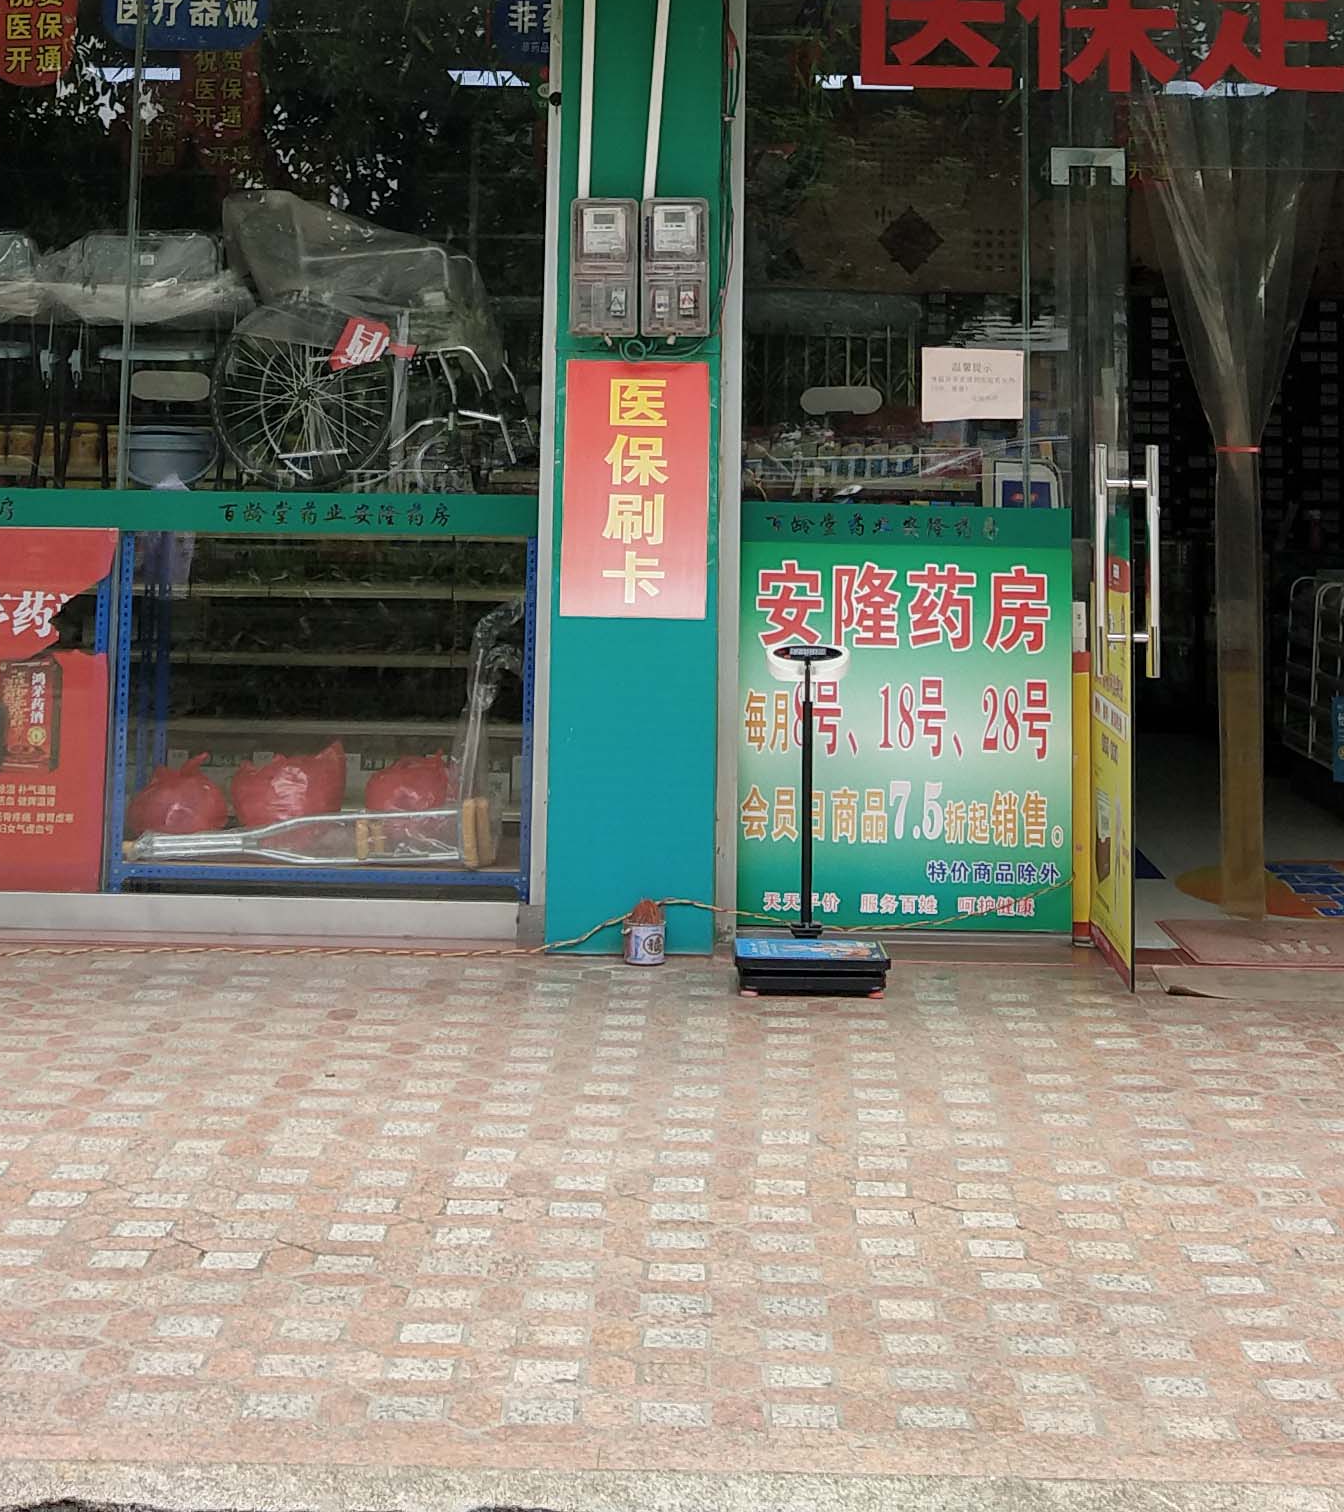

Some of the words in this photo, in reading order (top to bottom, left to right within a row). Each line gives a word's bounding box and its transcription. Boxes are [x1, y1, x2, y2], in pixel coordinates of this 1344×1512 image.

[6, 12, 64, 40] 医保
[5, 45, 63, 73] 开通
[601, 378, 669, 606] 医保刷卡
[756, 559, 1052, 655] 安隆药房
[926, 860, 1061, 887] 特价商品除外
[762, 891, 841, 914] 天天平价
[859, 892, 940, 915] 服务百姓
[957, 894, 1037, 918] 呵护健康
